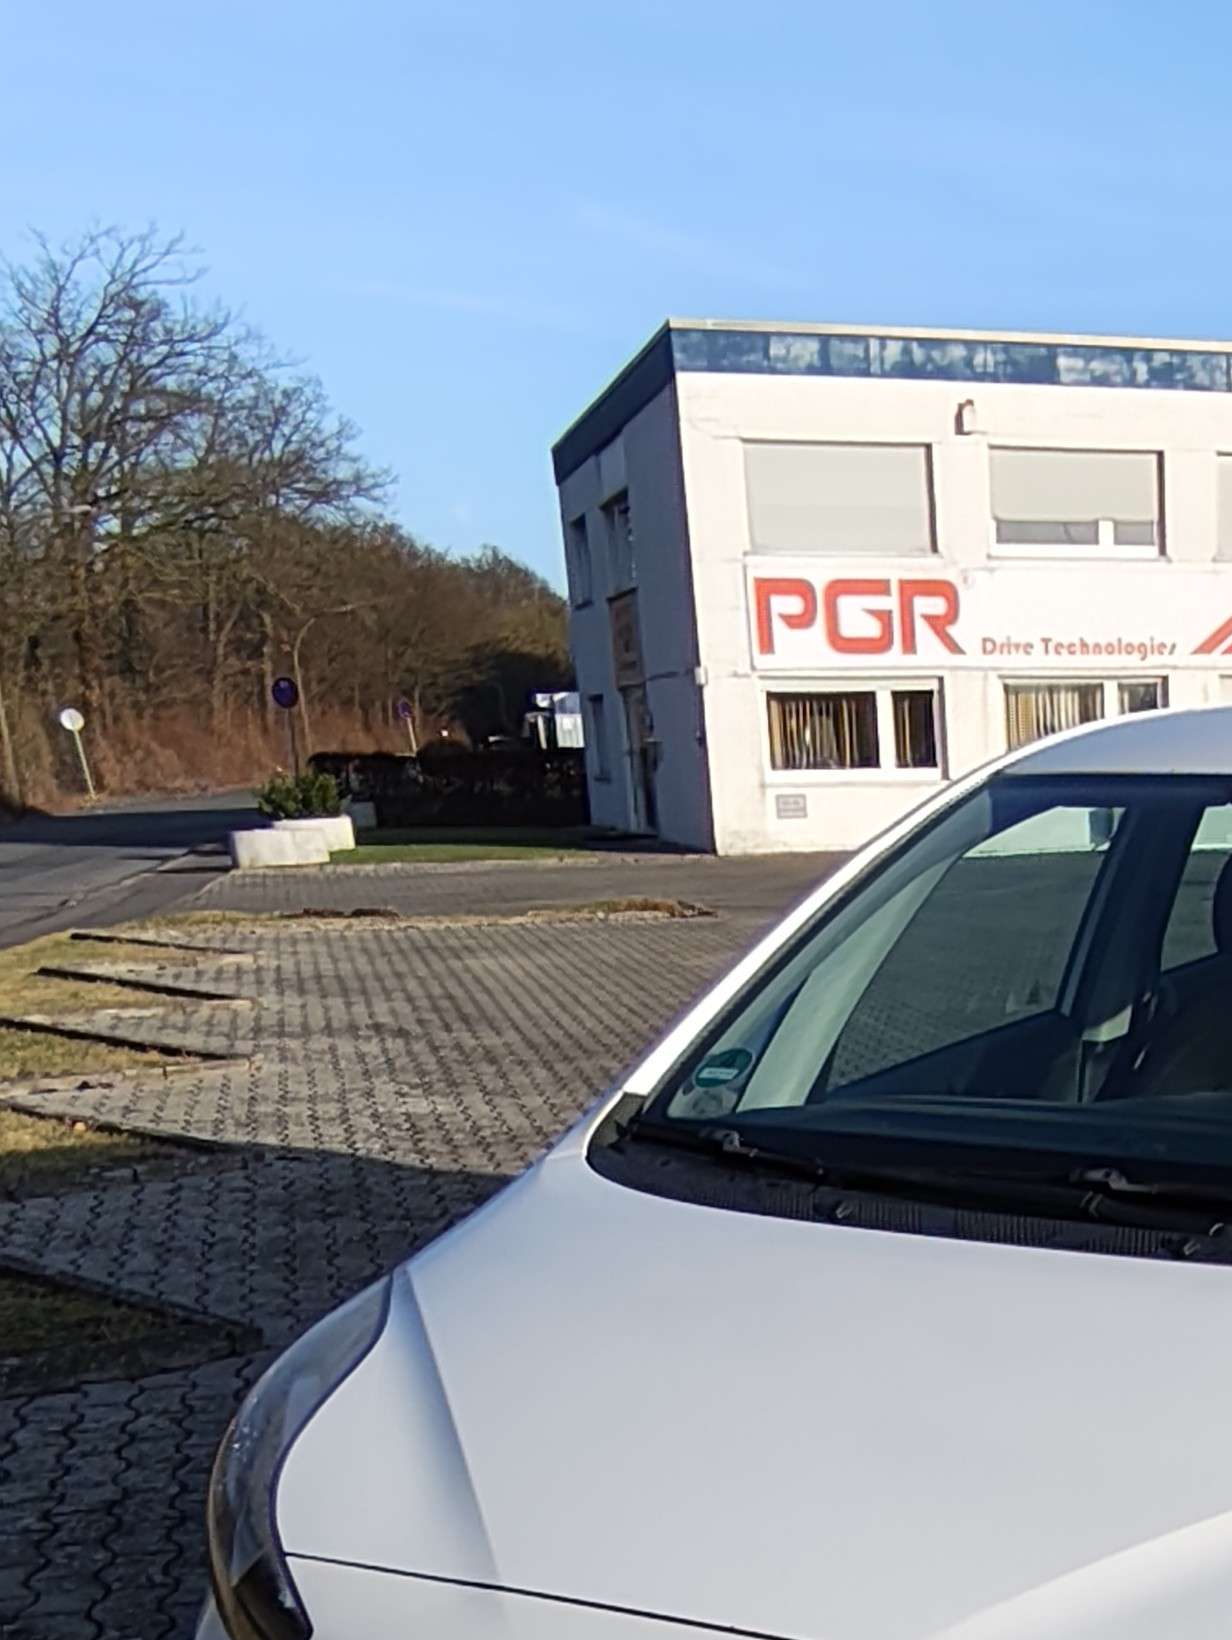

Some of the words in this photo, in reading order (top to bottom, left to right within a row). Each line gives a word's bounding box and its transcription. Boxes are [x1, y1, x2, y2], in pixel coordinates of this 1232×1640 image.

[754, 577, 967, 655] PGR
[981, 636, 1035, 656] Drive
[1041, 636, 1177, 662] Technologies
